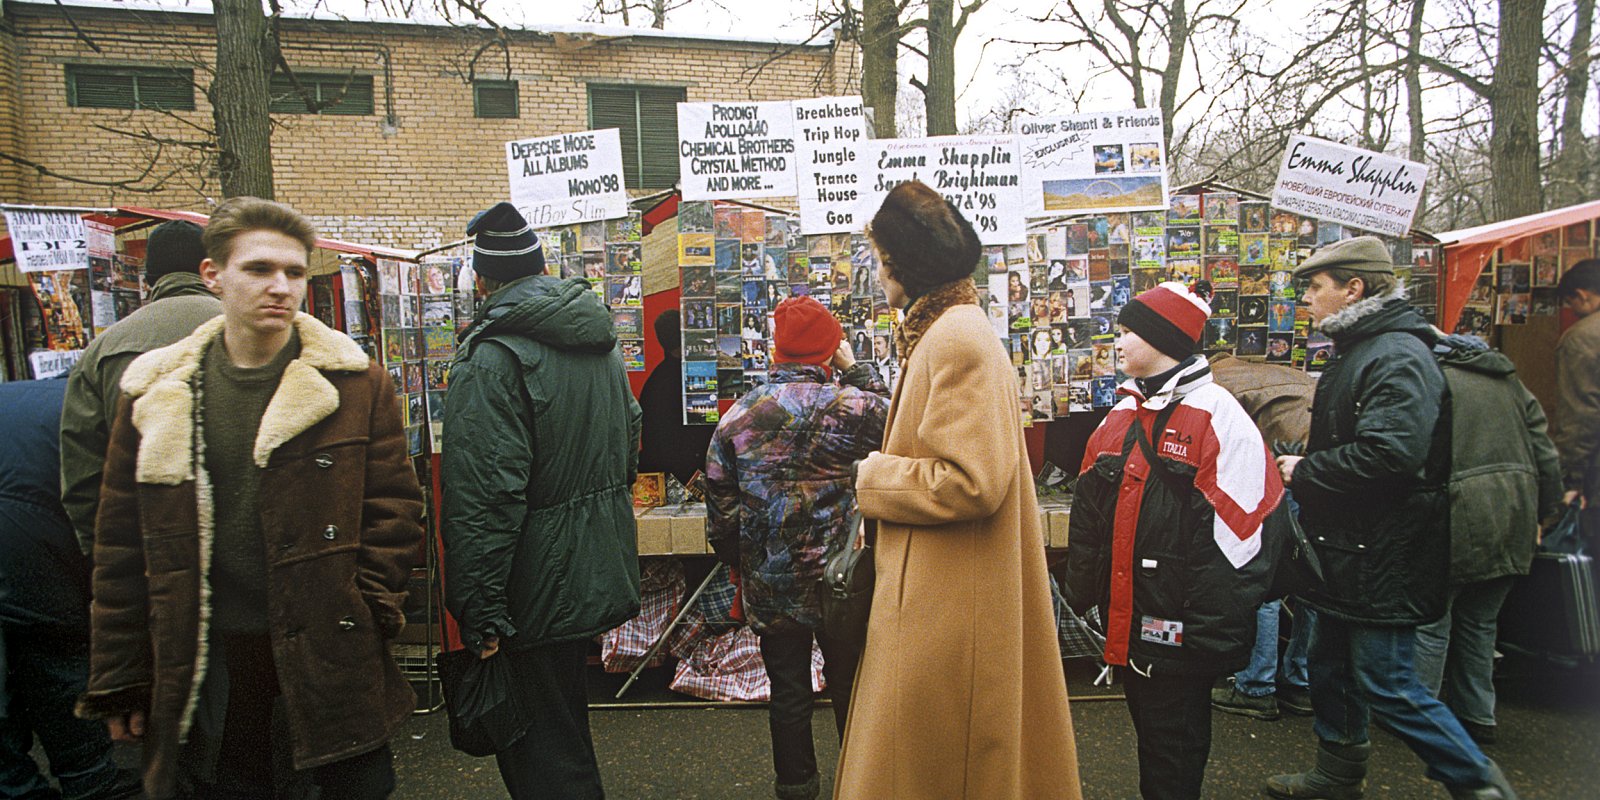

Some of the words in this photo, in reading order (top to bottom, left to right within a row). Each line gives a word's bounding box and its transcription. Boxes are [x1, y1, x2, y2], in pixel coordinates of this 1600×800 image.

[712, 104, 758, 121] PRODIGY
[796, 104, 864, 120] Breakbeat
[705, 120, 768, 138] APOLLO440
[1021, 122, 1057, 135] Oliver
[1061, 117, 1098, 131] Shanti
[1102, 117, 1113, 129] &
[1117, 114, 1160, 129] Friends
[804, 127, 830, 144] Trip
[834, 127, 860, 143] Hop
[511, 138, 561, 160] DEPECHE
[563, 135, 596, 152] MODE
[681, 139, 736, 158] CHEMICAL
[739, 136, 795, 155] BROTHERS
[691, 157, 739, 175] CRYSTAL
[741, 156, 786, 173] METHOD
[812, 147, 856, 167] Jungle
[877, 150, 926, 170] Emma
[939, 146, 1011, 169] Shapplin
[523, 159, 543, 178] ALL
[545, 157, 588, 175] ALBUMS
[1288, 141, 1344, 176] Emma
[1346, 155, 1418, 198] Shapplin
[706, 177, 729, 193] AND
[731, 176, 762, 191] MORE
[813, 172, 858, 186] Trance
[934, 169, 1018, 192] Brightman
[818, 187, 858, 204] House
[826, 211, 853, 226] Goa
[1166, 429, 1192, 444] FILA
[1163, 441, 1187, 457] ITALIA
